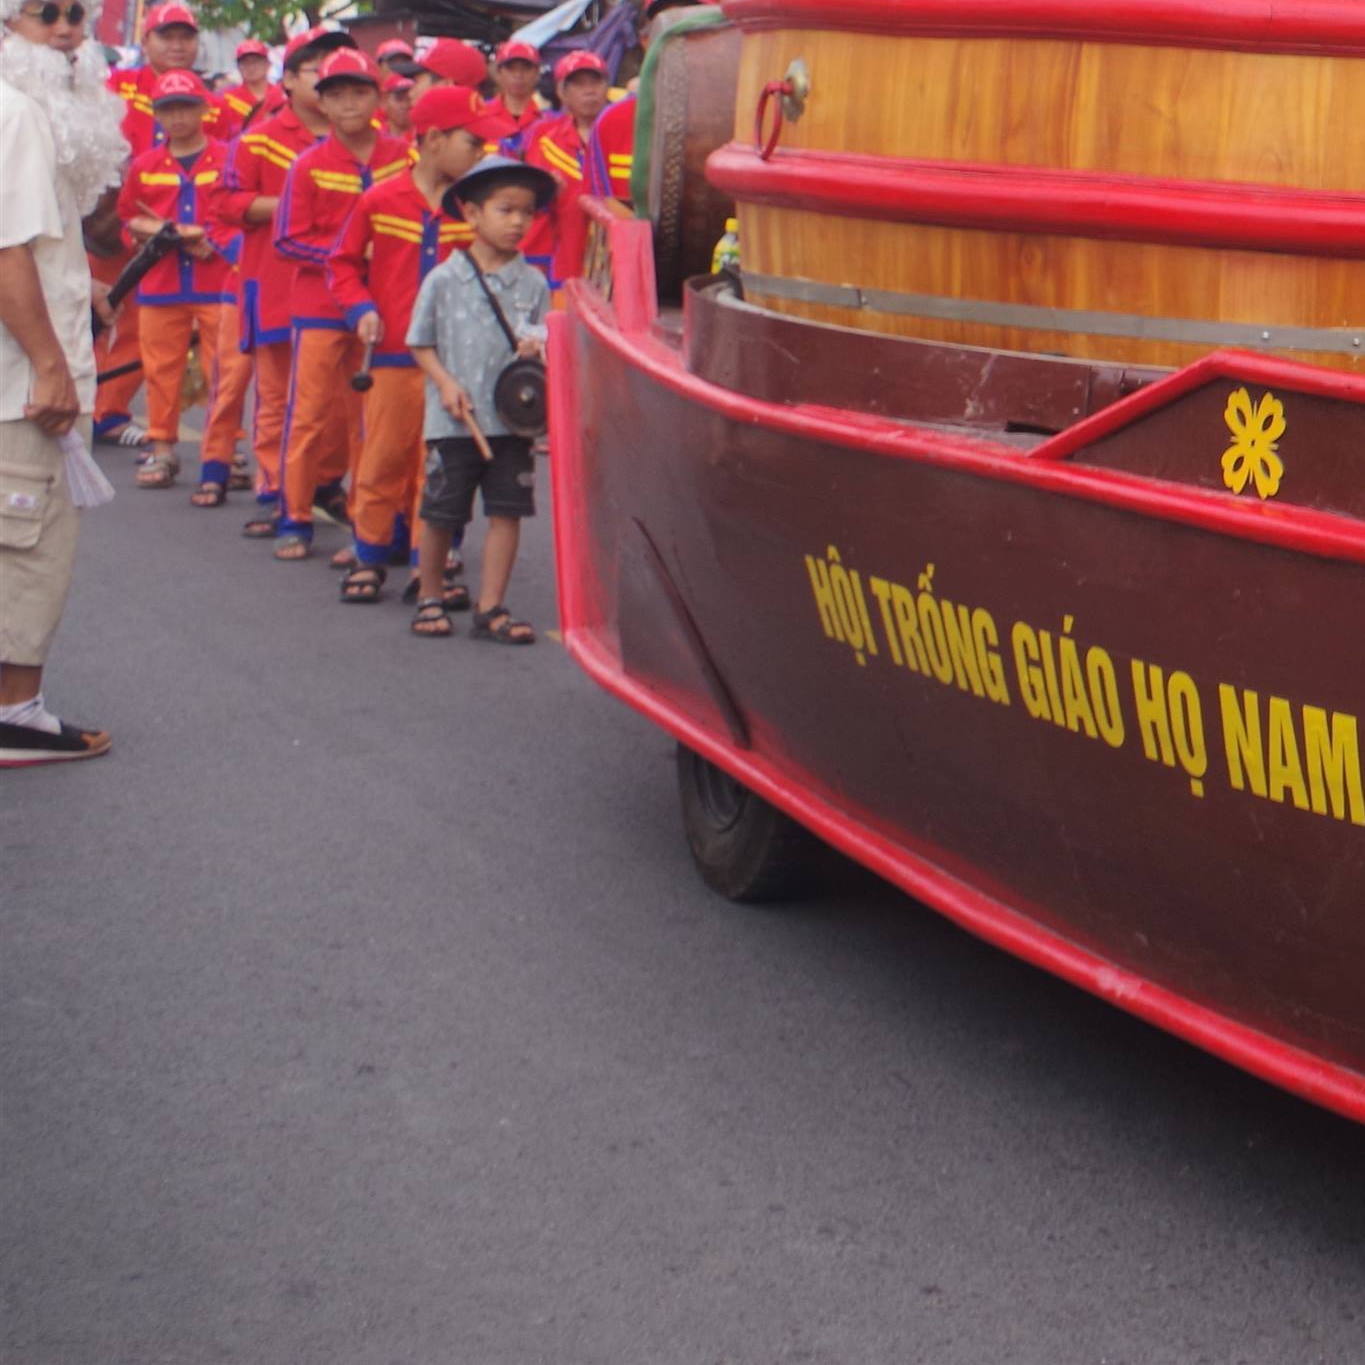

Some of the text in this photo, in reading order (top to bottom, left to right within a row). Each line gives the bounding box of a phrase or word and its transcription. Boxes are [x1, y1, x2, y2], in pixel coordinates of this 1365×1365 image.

[806, 546, 879, 665] HỘI
[868, 563, 1010, 705] TRỐNG
[1011, 615, 1126, 748] GIÁO
[1129, 658, 1206, 797] HỌ
